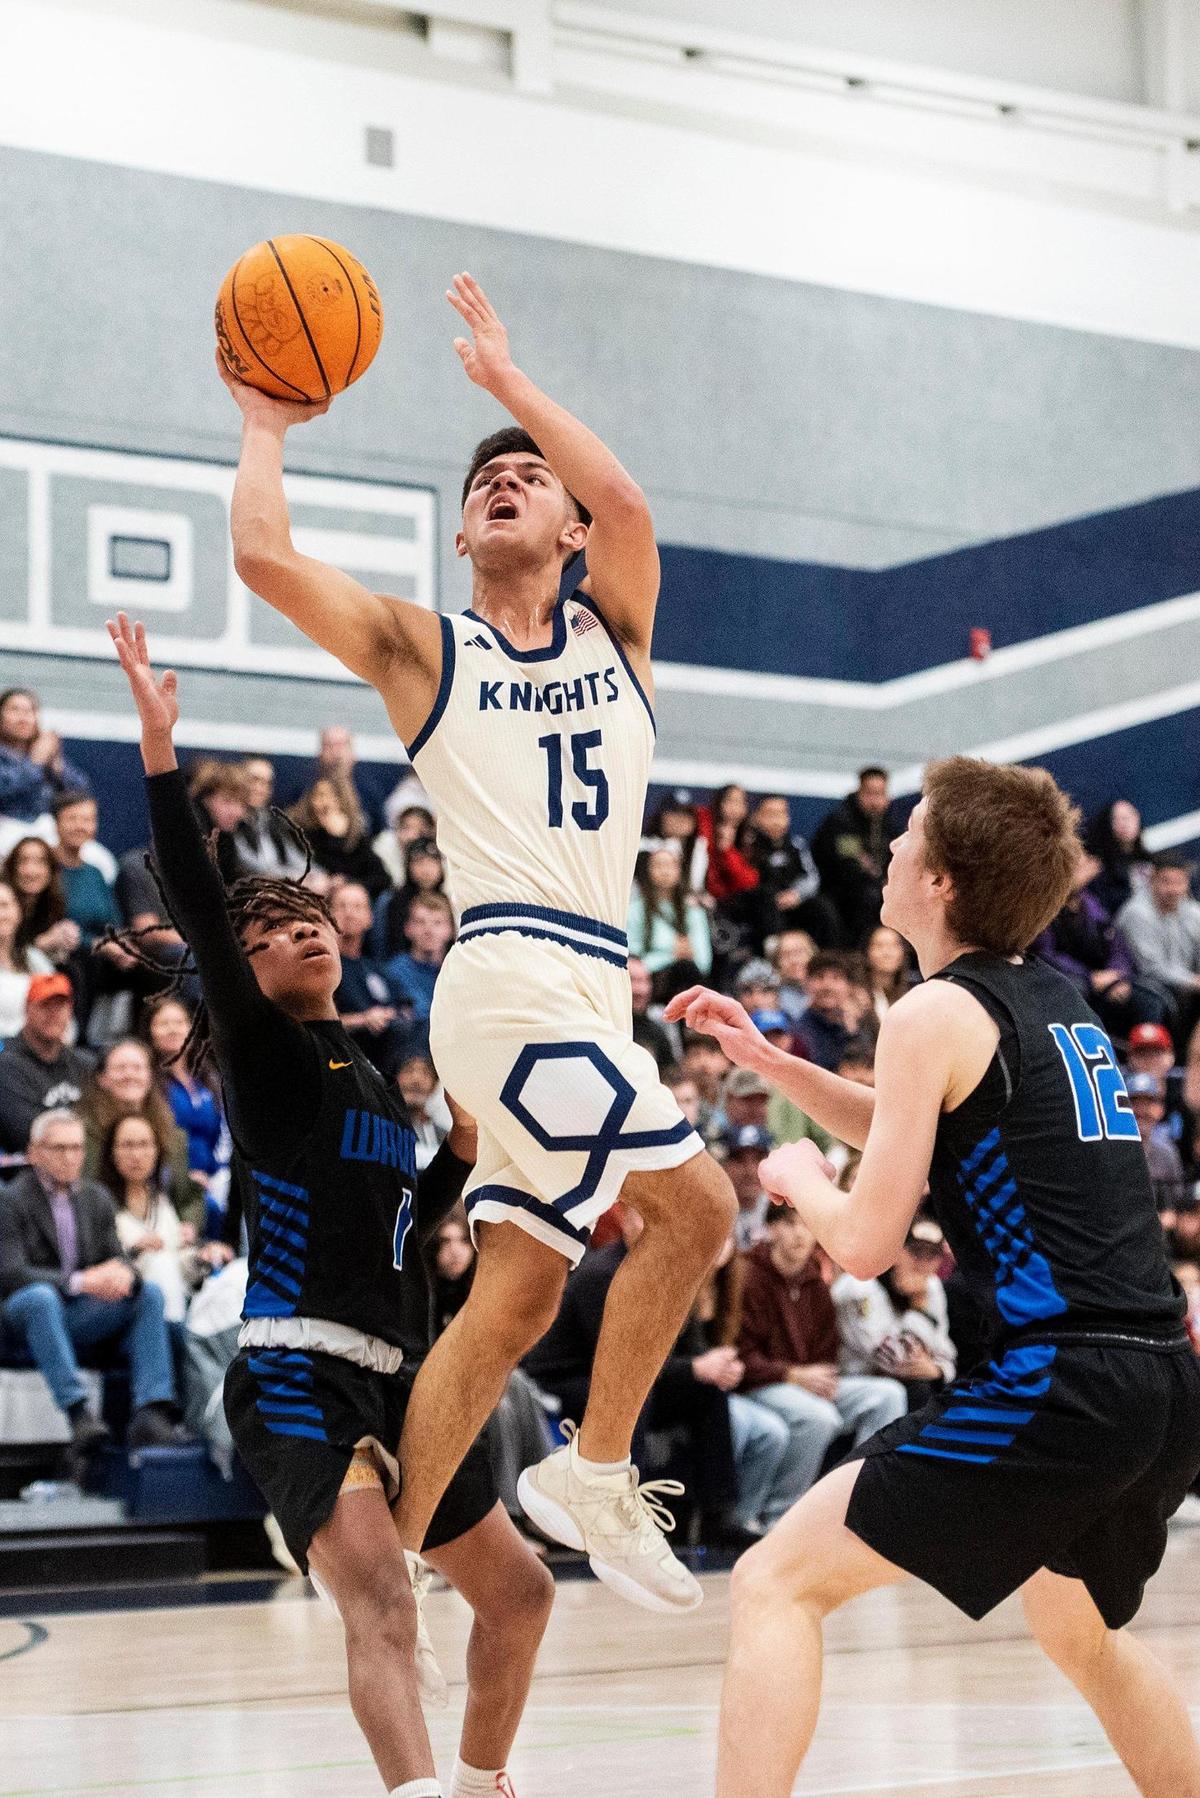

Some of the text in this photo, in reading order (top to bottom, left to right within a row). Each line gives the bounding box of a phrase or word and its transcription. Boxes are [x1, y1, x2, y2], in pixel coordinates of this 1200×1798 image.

[479, 667, 619, 715] KNIGHTS
[539, 729, 609, 831] 15
[1047, 1023, 1142, 1142] 12
